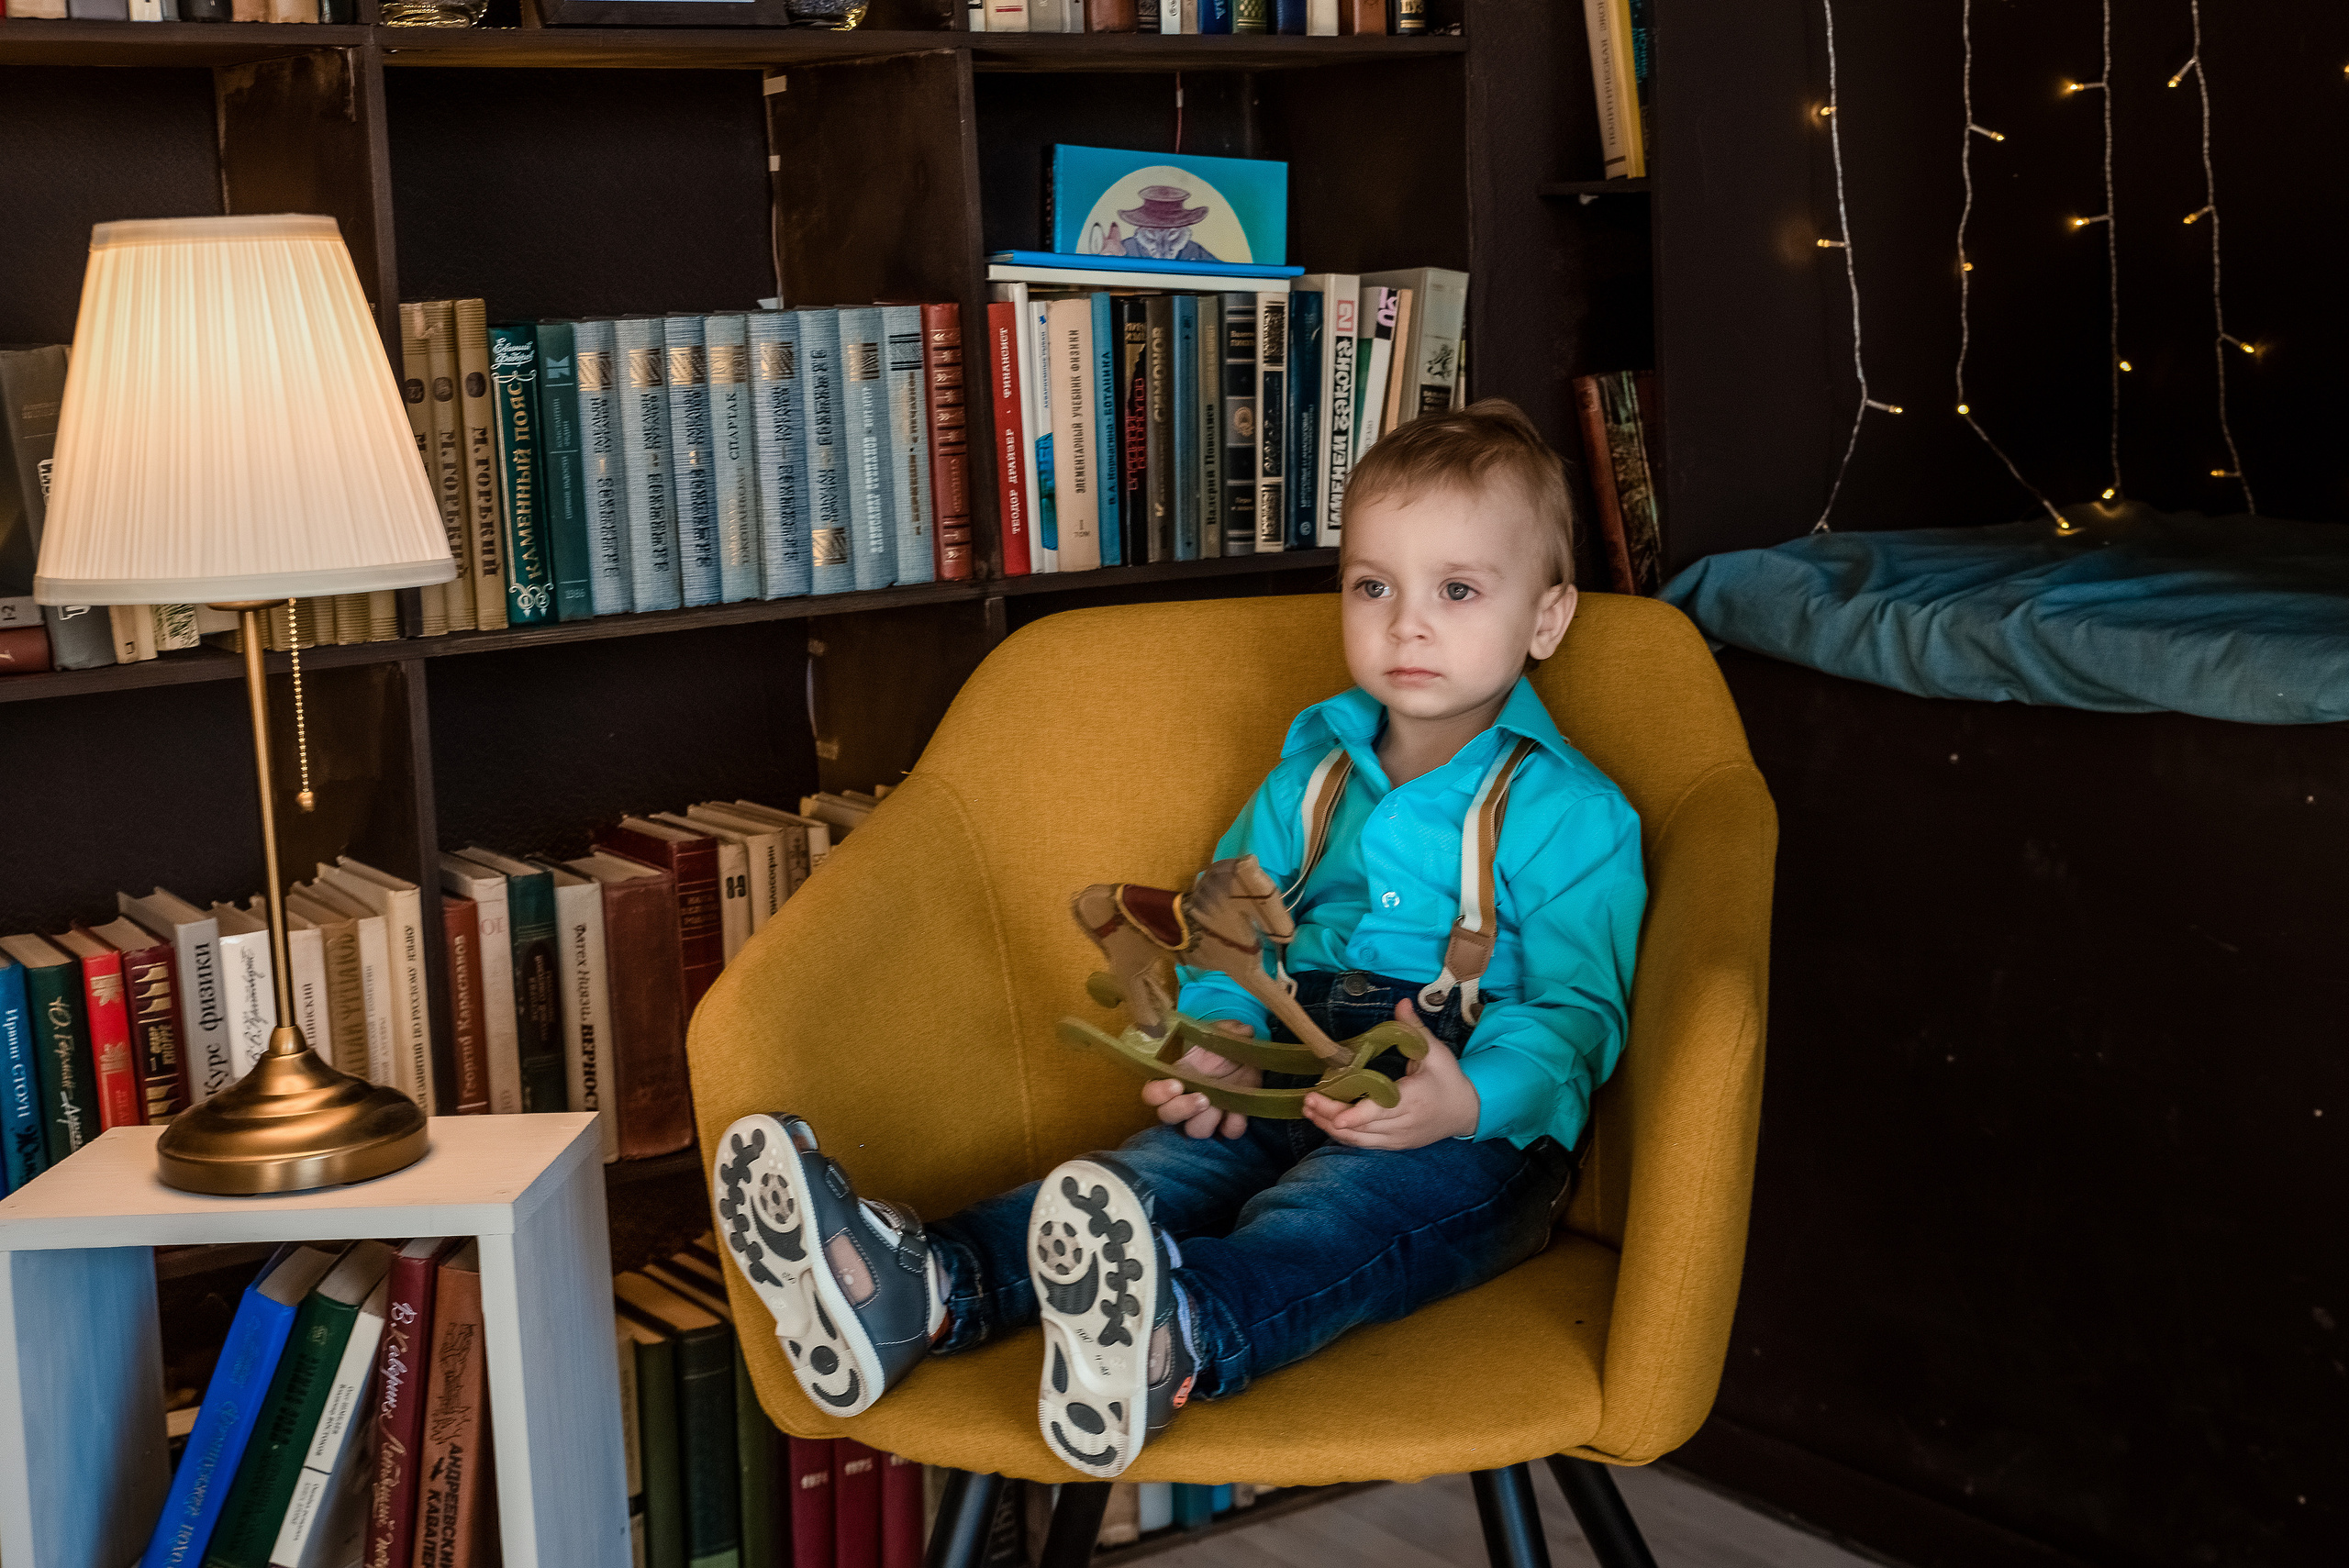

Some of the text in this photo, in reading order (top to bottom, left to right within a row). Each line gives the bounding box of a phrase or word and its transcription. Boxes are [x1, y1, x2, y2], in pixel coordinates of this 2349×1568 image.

[999, 327, 1014, 399] ФИНАНСИСТ
[1100, 351, 1113, 417] БОТАНИКА
[1151, 327, 1167, 423] СИМОНОВ
[726, 392, 741, 461] СПАРТАК
[1067, 329, 1086, 494] ЭЛЕМЕНТАРНЫЙ УЧЕБНИК ФИЗИКИ
[1328, 336, 1353, 528] ИМЕНЕМ ЗАКОНА
[471, 426, 502, 578] М. ГОРЬКИЙ
[507, 381, 543, 579] КАМЕННЫЙ ПОЯС
[1004, 428, 1022, 535] ТЕОДОР ДРАЙЗЕР
[403, 926, 416, 962] ЯЗЫКУ
[194, 942, 229, 1096] Курс физики
[407, 967, 421, 1020] РУССКОМУ
[3, 1007, 20, 1061] Ирвинг
[459, 1036, 478, 1098] Георгий
[580, 1024, 599, 1112] ВЕРНОСТ
[11, 1063, 31, 1118] СТОУН
[390, 1302, 417, 1329] В.
